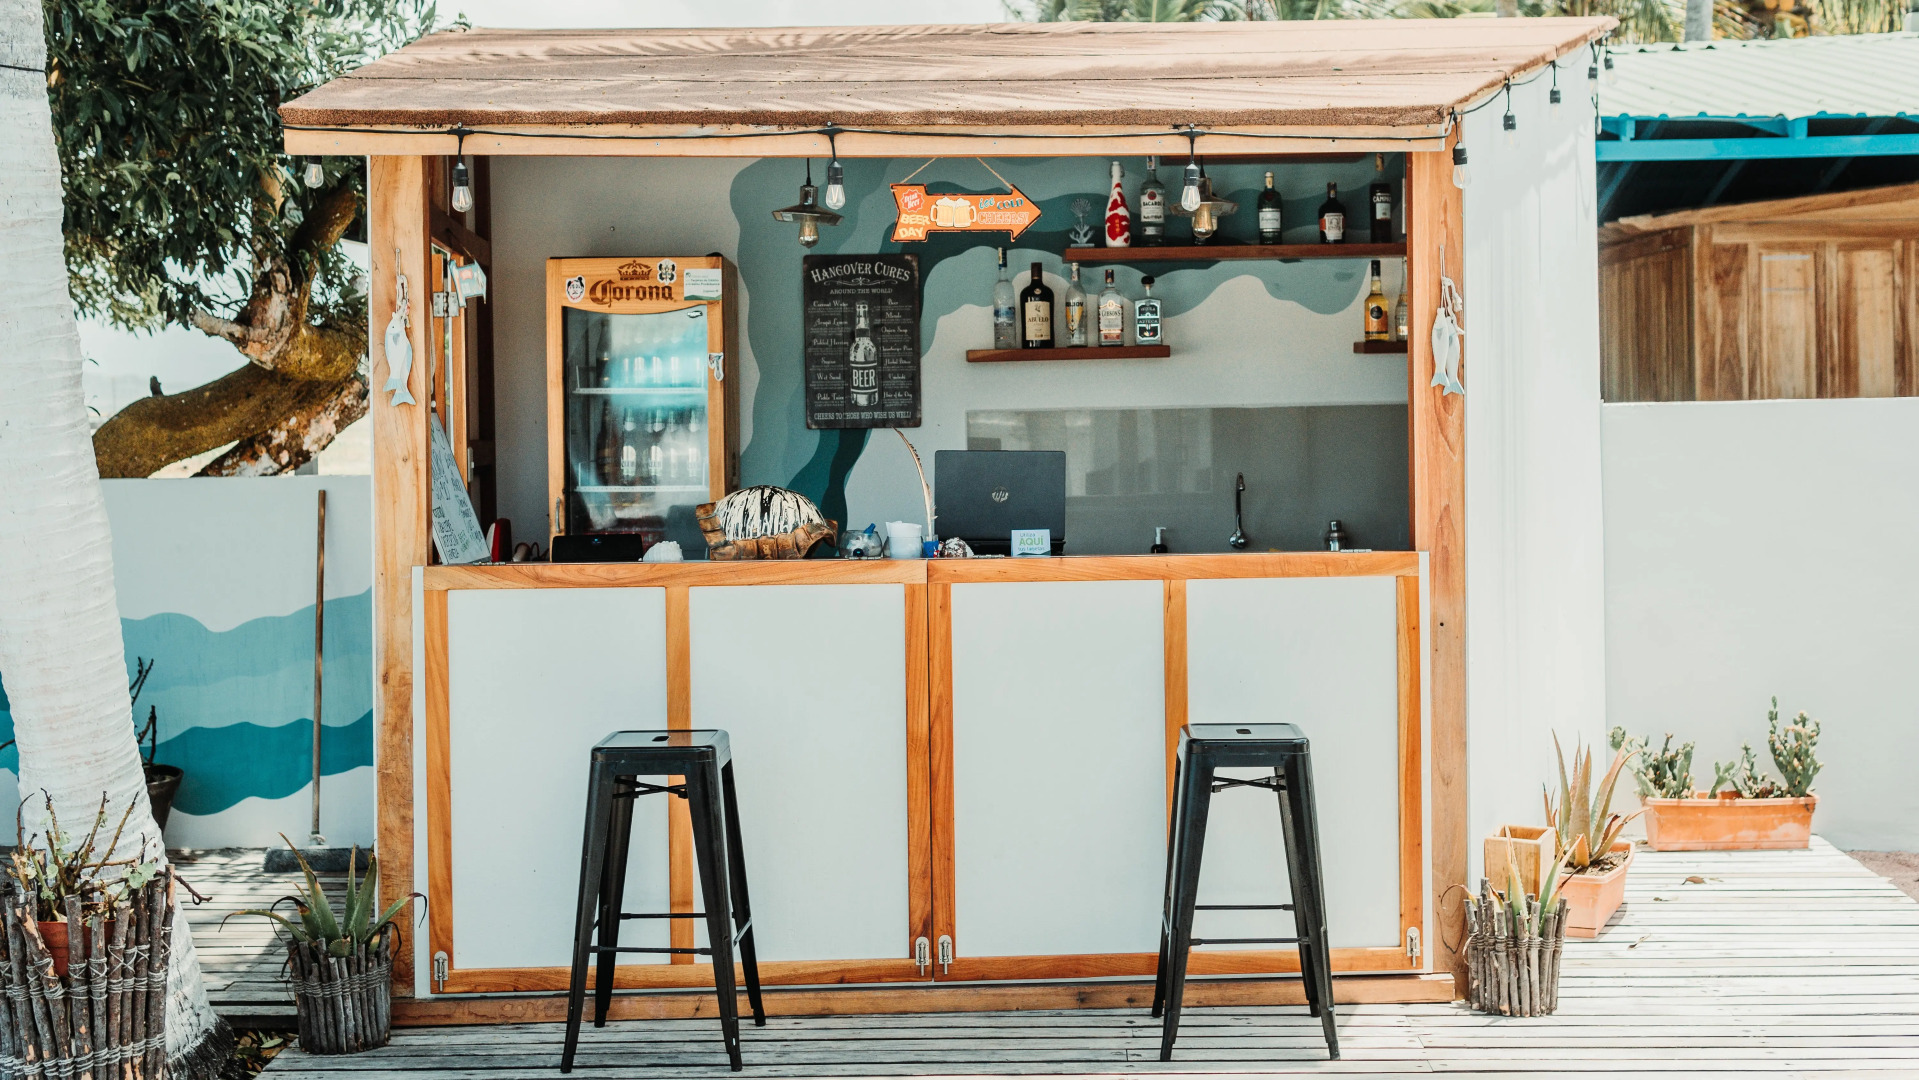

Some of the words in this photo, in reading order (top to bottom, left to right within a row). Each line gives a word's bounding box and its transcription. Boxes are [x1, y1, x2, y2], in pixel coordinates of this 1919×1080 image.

[904, 193, 918, 203] Drink
[907, 199, 920, 210] Beer
[996, 198, 1024, 210] COLD
[900, 214, 931, 225] BEER
[978, 212, 1029, 224] CHEERS!
[898, 227, 924, 238] DAY
[810, 262, 872, 283] HANGOVER
[874, 262, 910, 282] CURES
[589, 280, 674, 308] Corona
[852, 369, 876, 388] BEER
[814, 412, 834, 420] CHEERS
[1019, 536, 1044, 546] AQUÍ
